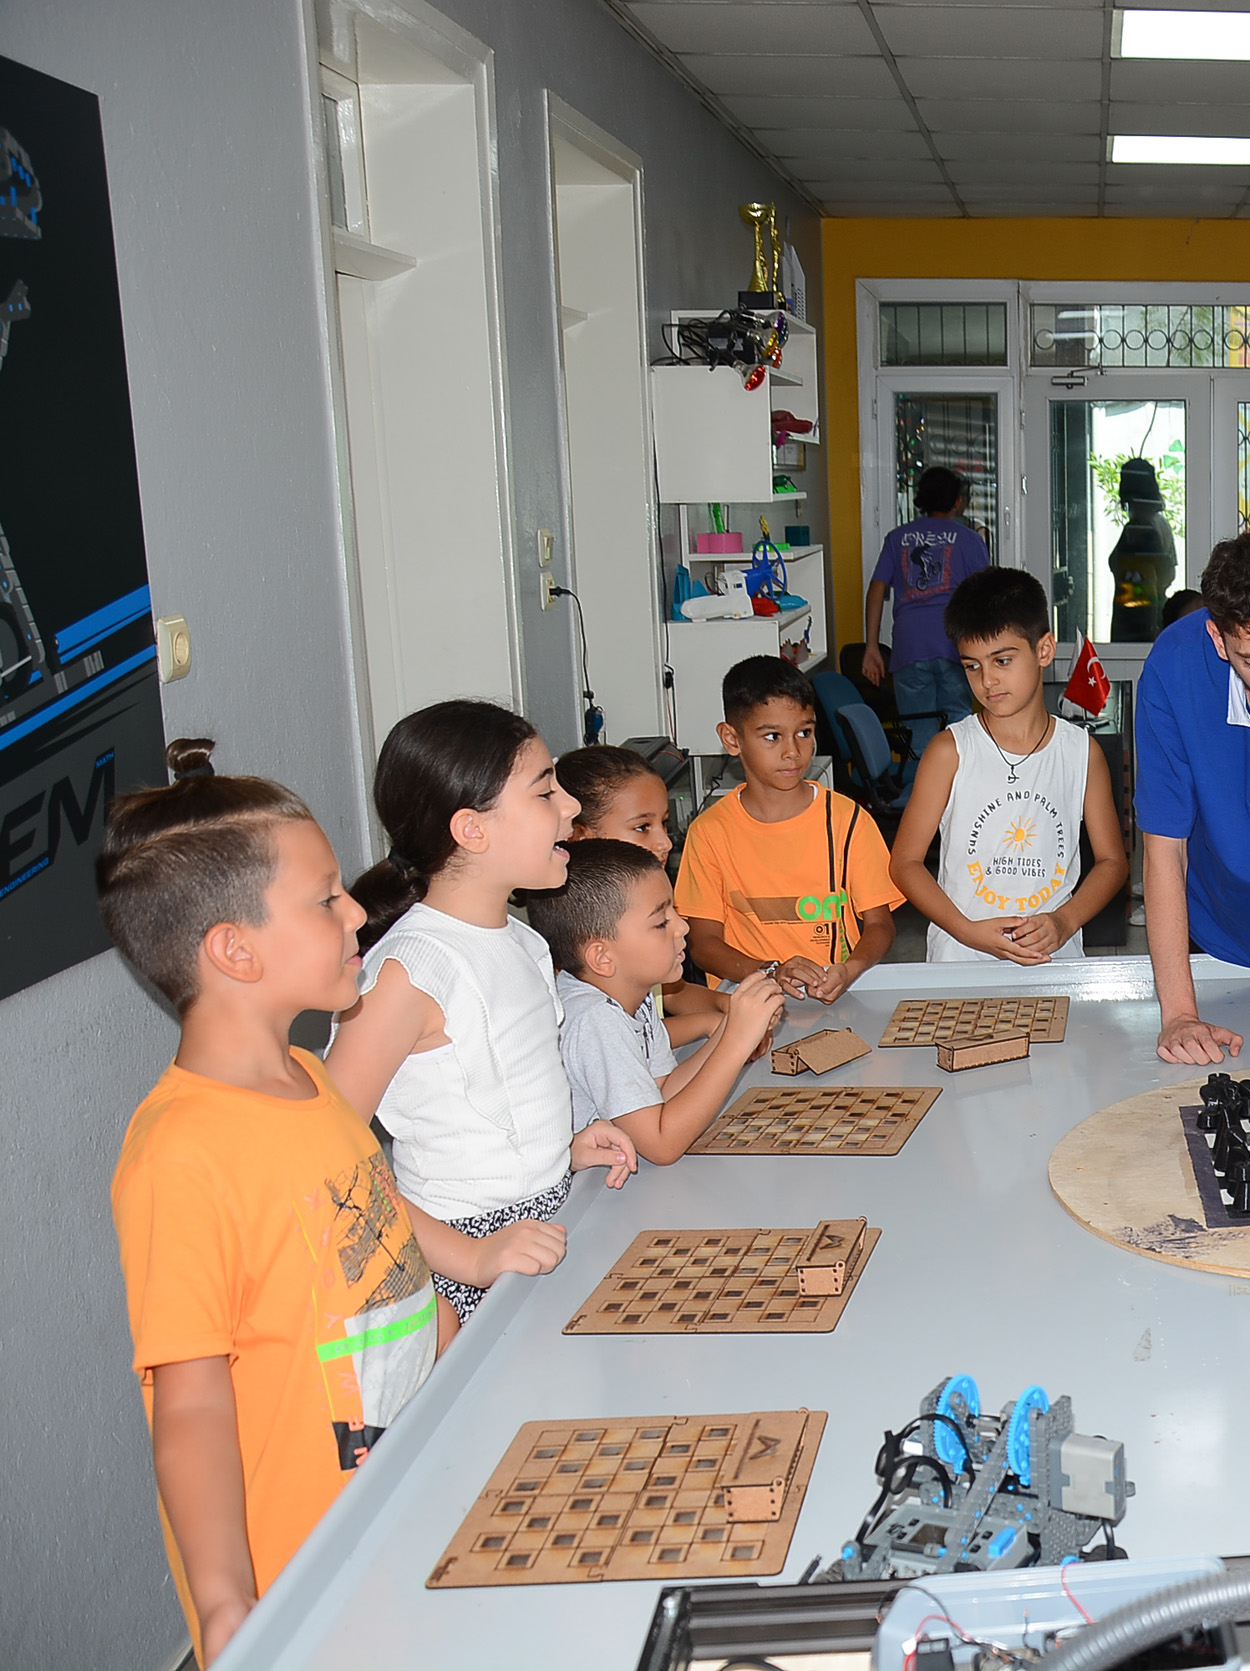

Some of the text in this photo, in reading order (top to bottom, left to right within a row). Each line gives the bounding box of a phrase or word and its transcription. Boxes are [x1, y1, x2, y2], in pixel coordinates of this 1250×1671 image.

[96, 752, 114, 768] MATH
[968, 791, 1065, 858] SUNSHINE AND PALM TREES
[985, 866, 1046, 878] & GOOD VIBES
[993, 857, 1042, 868] HIGH TIDES
[0, 857, 49, 897] ENGINEERING
[967, 860, 1066, 911] ENJOY TODAY
